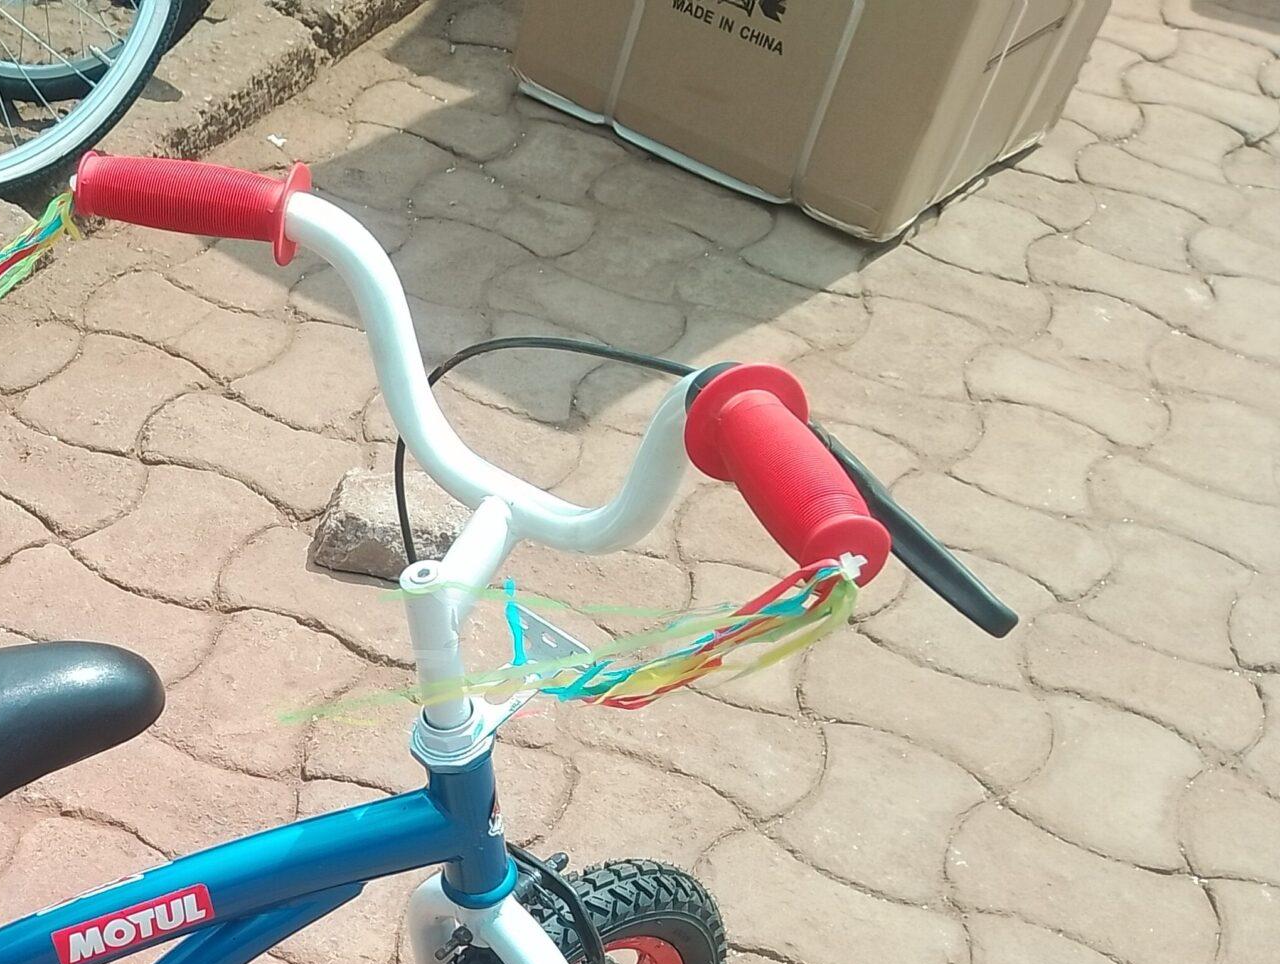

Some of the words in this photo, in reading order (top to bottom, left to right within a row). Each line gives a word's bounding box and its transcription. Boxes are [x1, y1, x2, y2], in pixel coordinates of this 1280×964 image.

[672, 0, 715, 25] MADE
[719, 15, 735, 33] IN
[739, 26, 784, 56] CHINA
[69, 893, 206, 964] MOTUL
